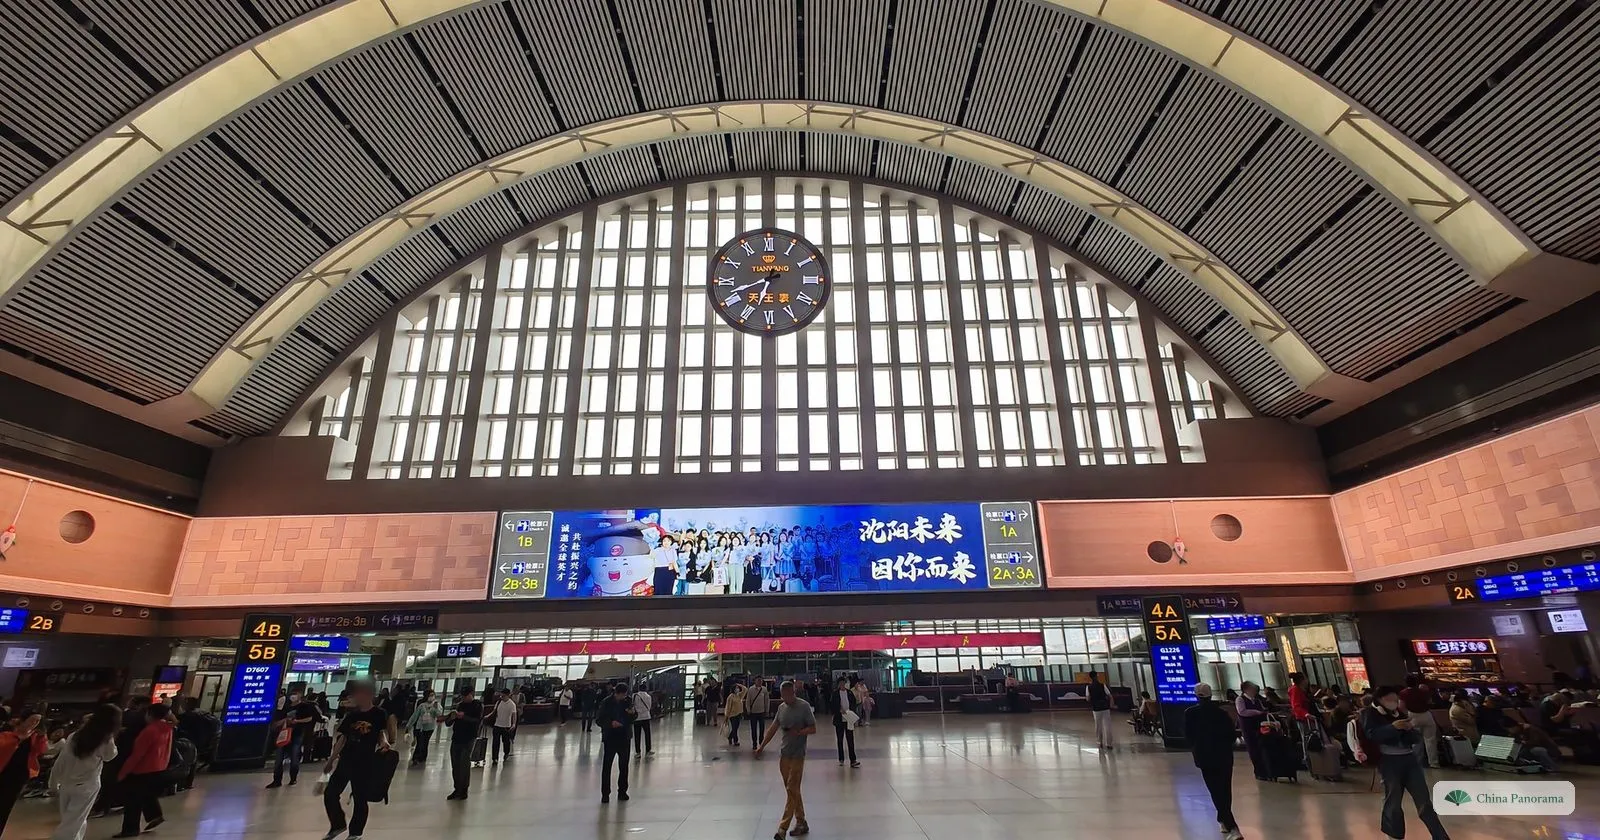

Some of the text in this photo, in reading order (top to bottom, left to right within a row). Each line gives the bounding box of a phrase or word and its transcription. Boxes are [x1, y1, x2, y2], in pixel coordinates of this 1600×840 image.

[741, 241, 755, 257] XI
[764, 237, 774, 252] XII
[752, 265, 790, 273] TIANWANG
[748, 292, 790, 303] 天王表
[763, 310, 775, 325] VI
[859, 512, 963, 544] 沈阳未来
[1000, 525, 1017, 538] 1A
[518, 535, 533, 547] 1B
[556, 524, 570, 581] 诚邀全球英才
[568, 532, 581, 590] 共赴振兴之约
[871, 551, 977, 585] 因你而来
[1454, 586, 1475, 600] 2A
[1151, 603, 1177, 618] 4A
[30, 616, 53, 630] 2B
[253, 621, 281, 637] 4B
[1155, 625, 1181, 640] 5A
[248, 644, 276, 660] 5B
